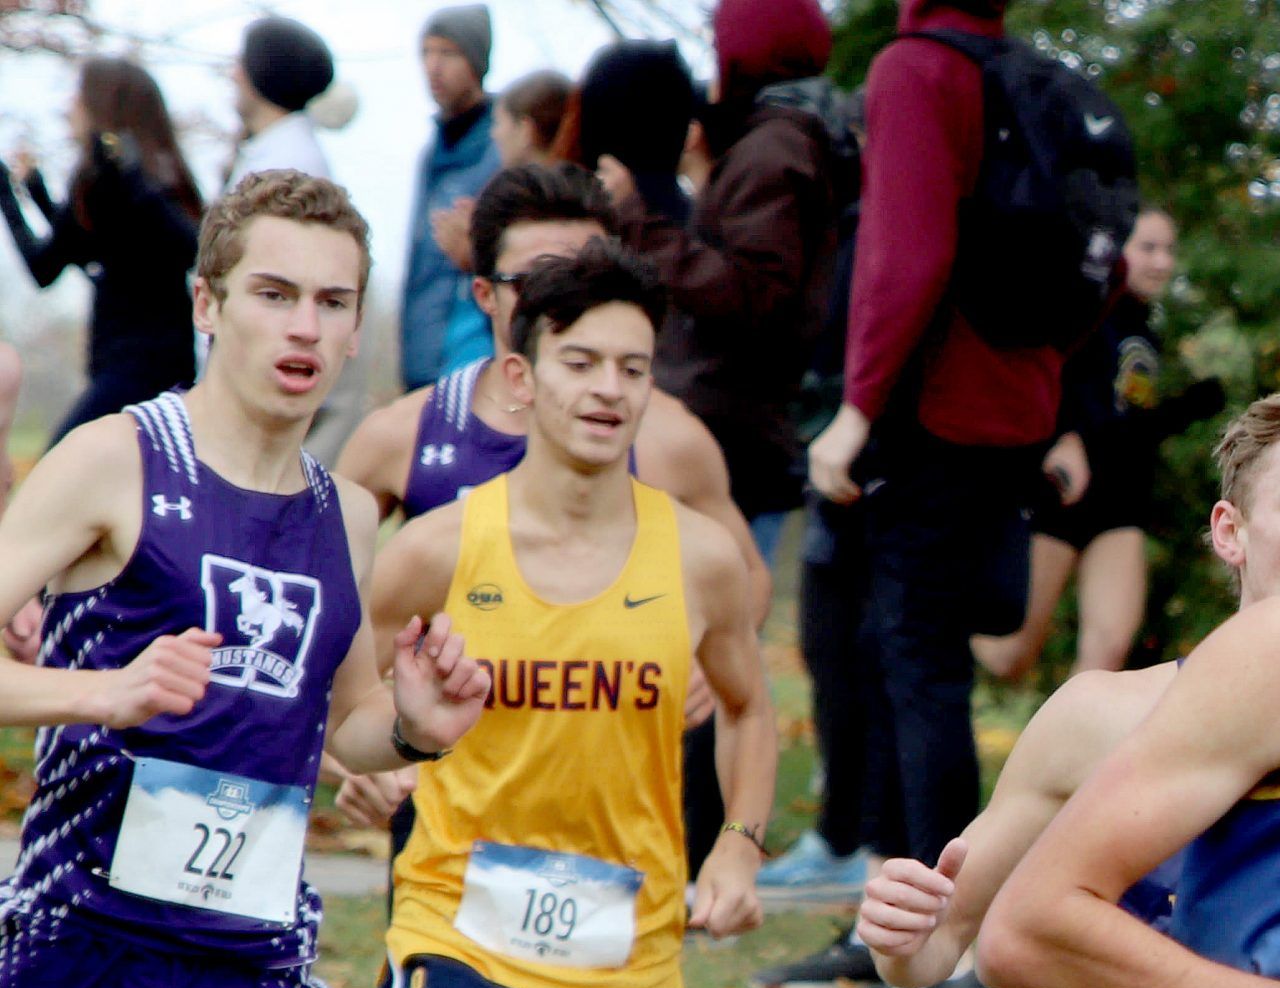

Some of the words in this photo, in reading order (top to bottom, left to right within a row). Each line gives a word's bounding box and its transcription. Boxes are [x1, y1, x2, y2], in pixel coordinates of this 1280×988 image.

[211, 650, 294, 685] MUSTANGS
[184, 823, 246, 880] 222
[521, 888, 578, 940] 189
